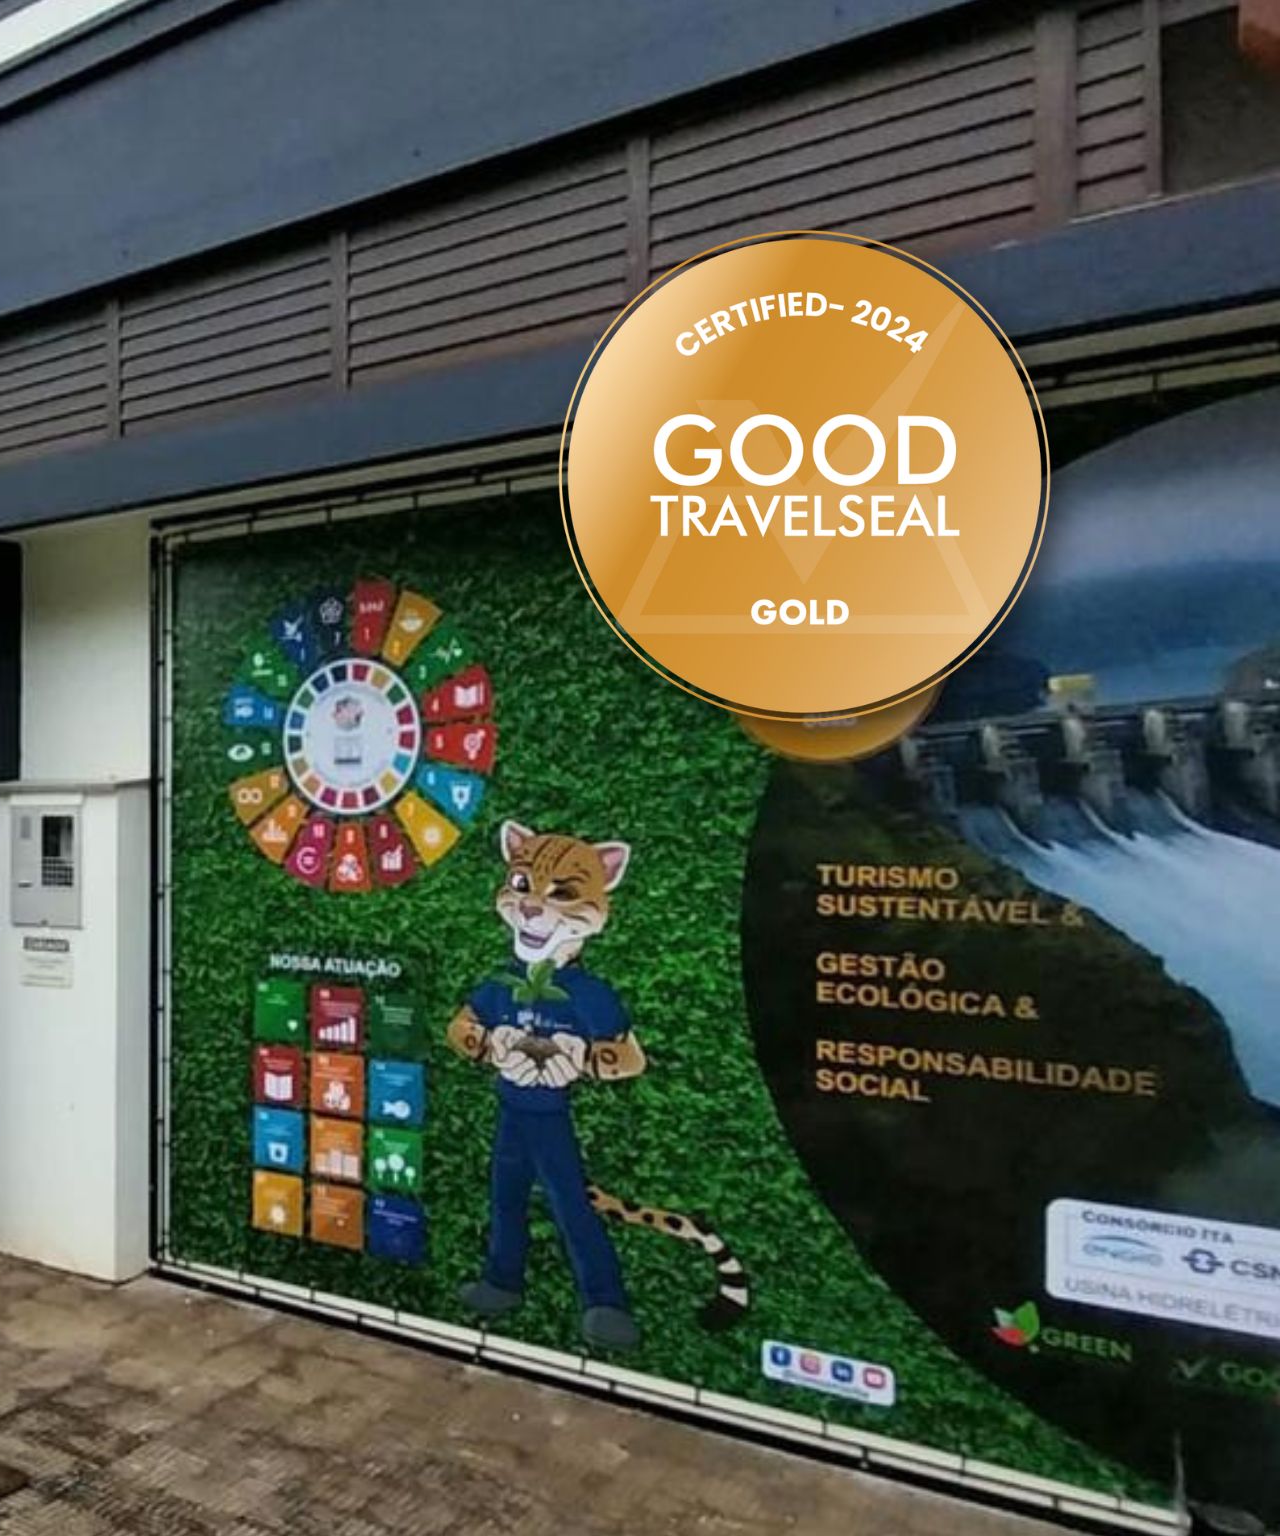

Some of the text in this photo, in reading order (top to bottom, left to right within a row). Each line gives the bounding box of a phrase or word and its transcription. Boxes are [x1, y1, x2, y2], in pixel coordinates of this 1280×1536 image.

[816, 863, 959, 891] TURISMO
[816, 894, 1085, 927] SUSTENTÁVEL &
[270, 953, 402, 979] NOSSA ATUAÇÃO
[816, 951, 946, 982] GESTÃO
[816, 981, 1040, 1020] ECOLÓGICA &
[816, 1039, 1158, 1097] RESPONSABILIDADE
[816, 1069, 932, 1103] SOCIAL
[1041, 1327, 1132, 1363] GREEN
